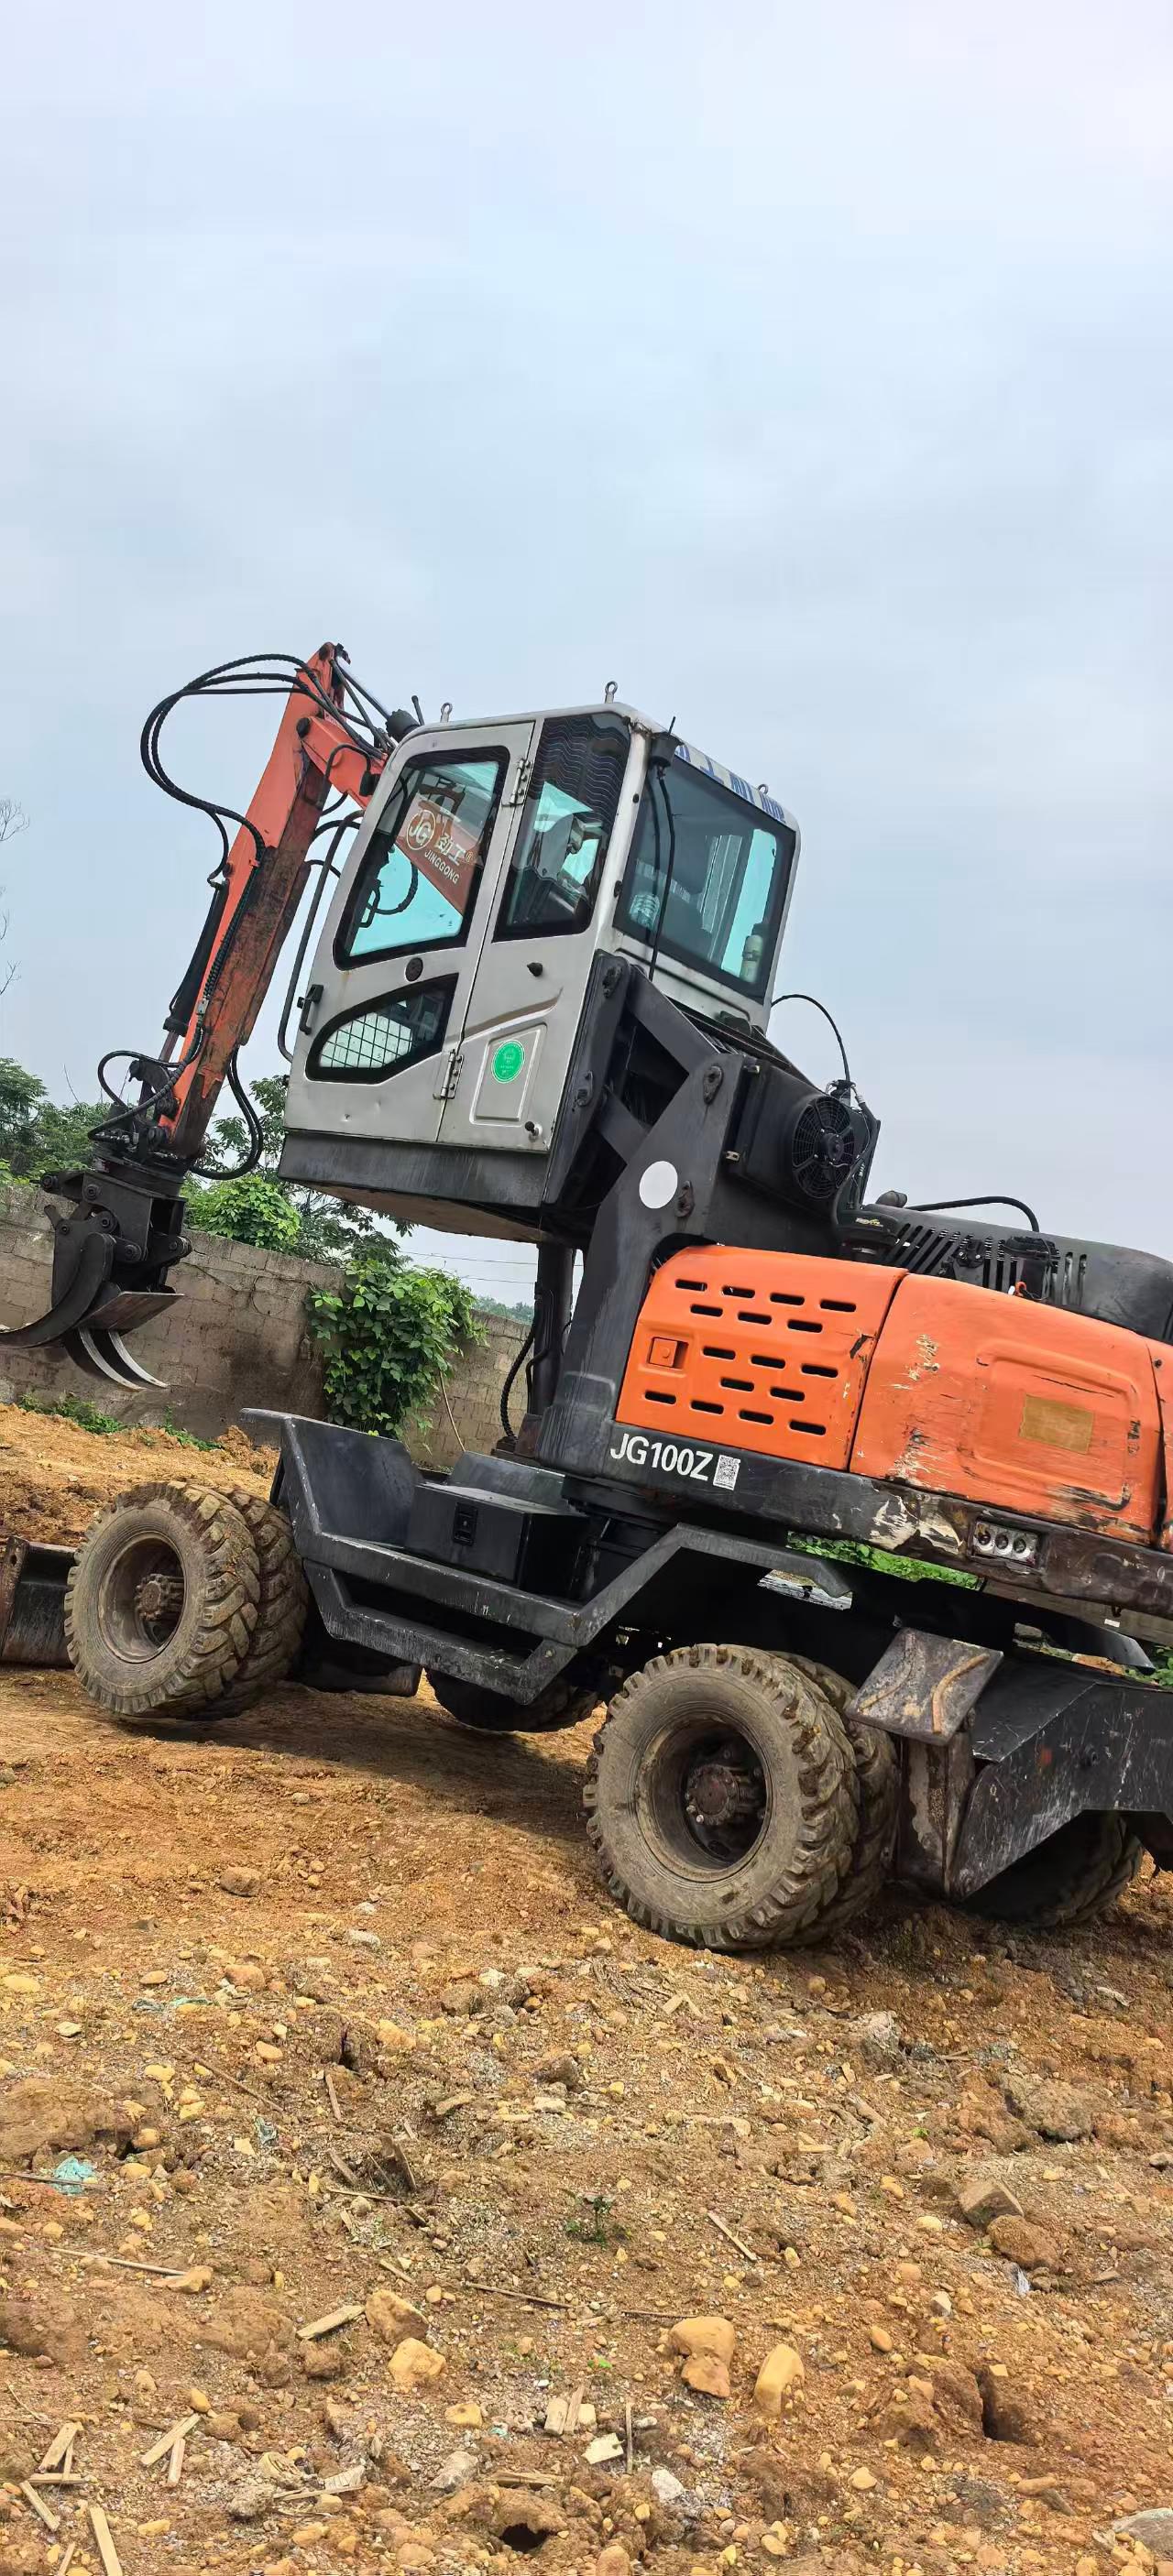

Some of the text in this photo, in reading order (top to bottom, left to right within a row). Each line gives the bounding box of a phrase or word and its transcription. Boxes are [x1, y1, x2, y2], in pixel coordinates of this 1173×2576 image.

[408, 815, 433, 845] JG
[424, 849, 460, 884] JINGGONG
[609, 1433, 714, 1481] JG100Z
